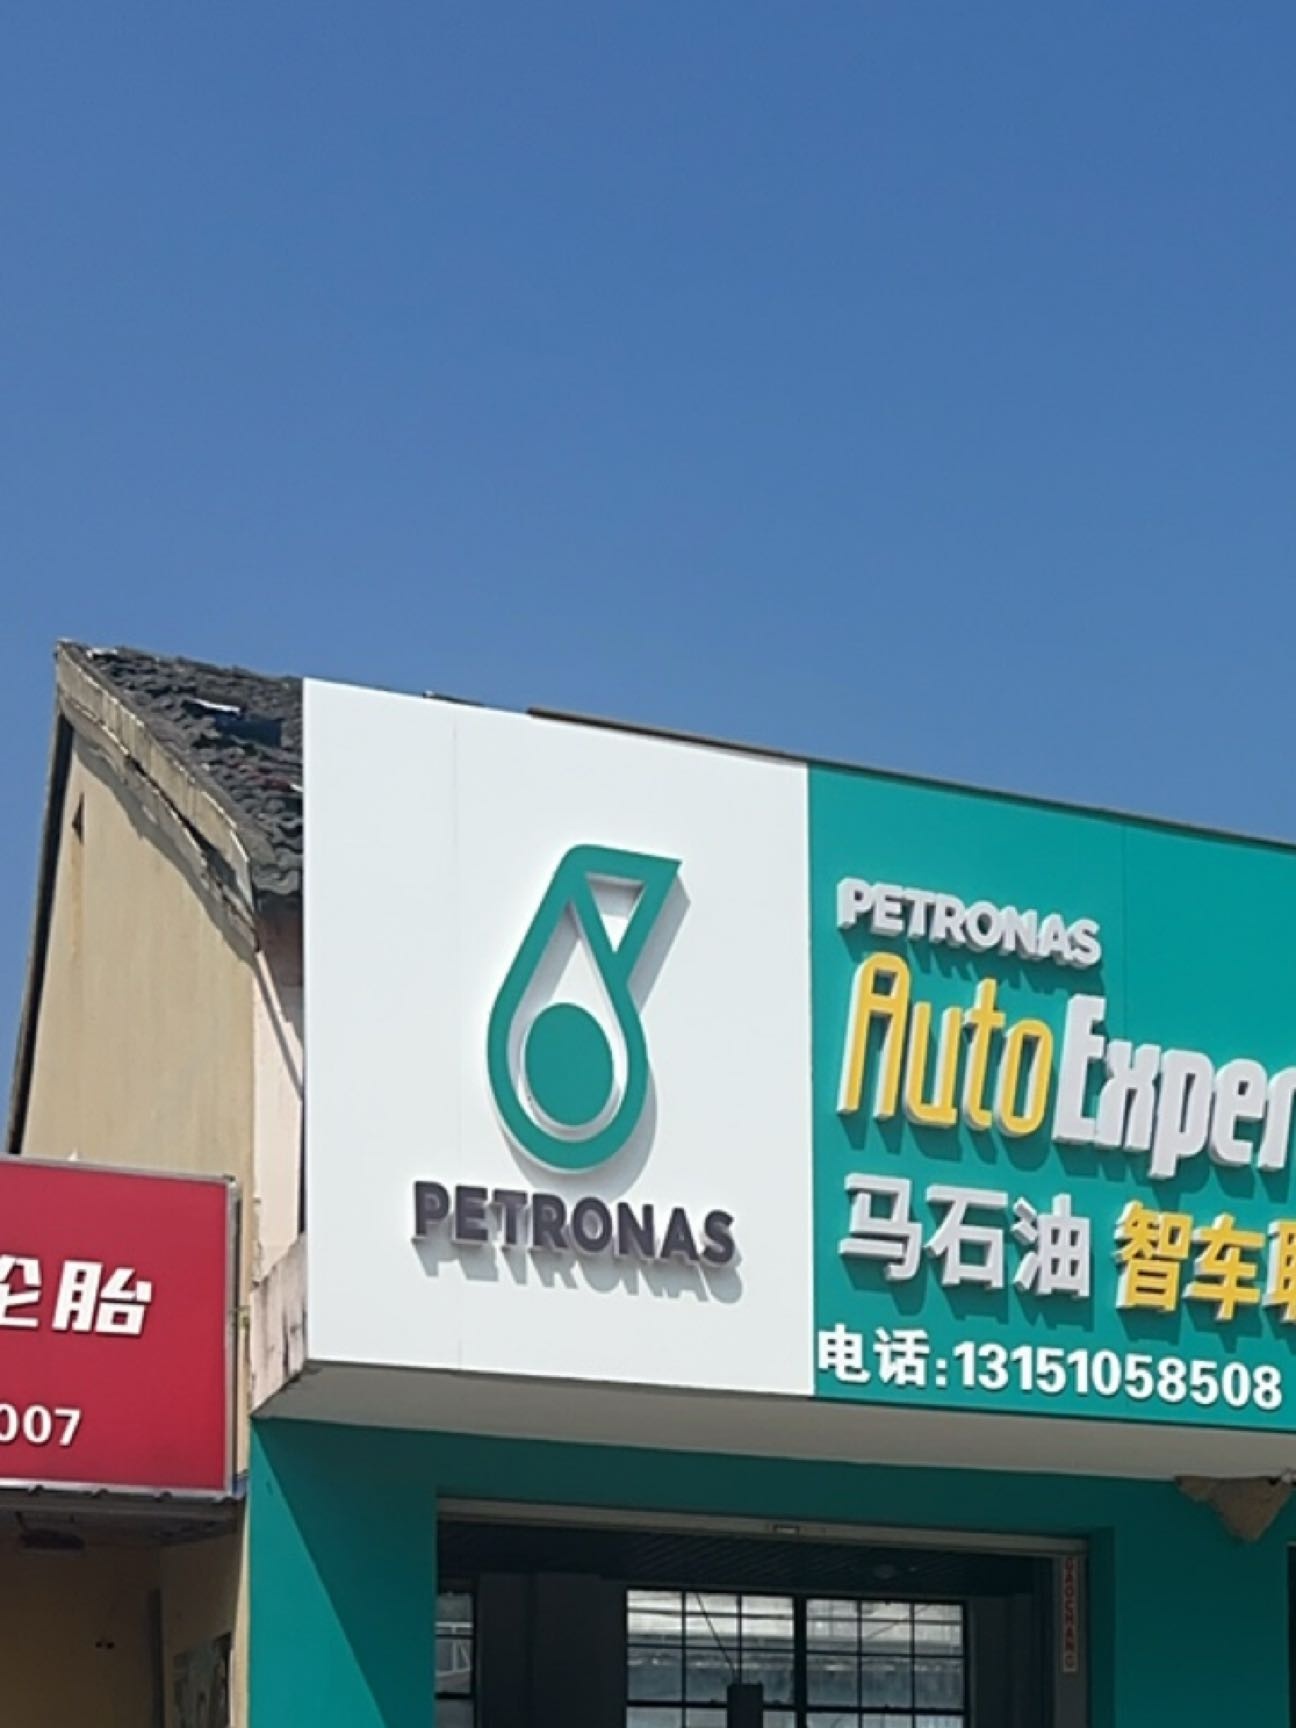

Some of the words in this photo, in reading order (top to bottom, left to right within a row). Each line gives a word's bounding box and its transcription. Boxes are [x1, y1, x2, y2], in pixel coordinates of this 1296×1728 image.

[836, 877, 1102, 970] PETRONAS
[411, 1180, 738, 1265] PETRONAS
[839, 1172, 1090, 1298] 马石油
